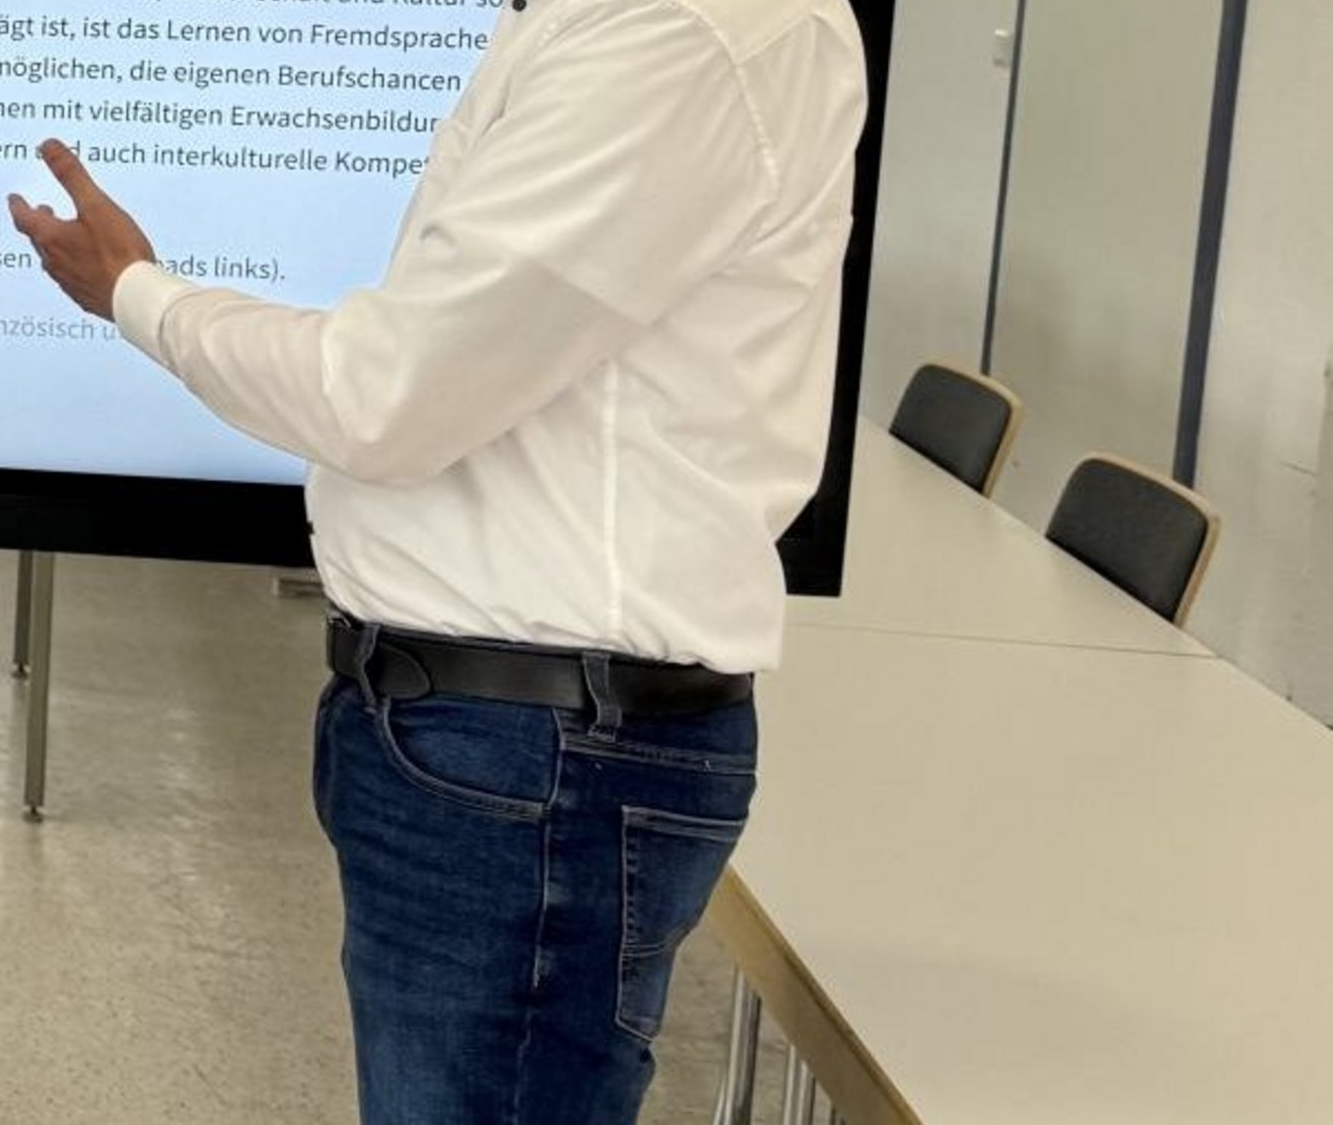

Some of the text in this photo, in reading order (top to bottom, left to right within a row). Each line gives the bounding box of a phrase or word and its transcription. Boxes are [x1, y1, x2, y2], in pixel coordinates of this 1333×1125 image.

[41, 15, 76, 41] ist,
[82, 16, 111, 39] ist
[116, 17, 160, 40] das
[166, 19, 251, 42] Lernen
[257, 26, 304, 44] von
[310, 23, 488, 53] Fremdsprache
[129, 59, 168, 82] die
[172, 61, 271, 90] eigenen
[277, 64, 461, 92] Berufschancen
[42, 99, 83, 121] mit
[88, 99, 223, 131] vielfältigen
[87, 142, 146, 164] auch
[153, 143, 328, 172] interkulturelle
[213, 256, 286, 283] links).
